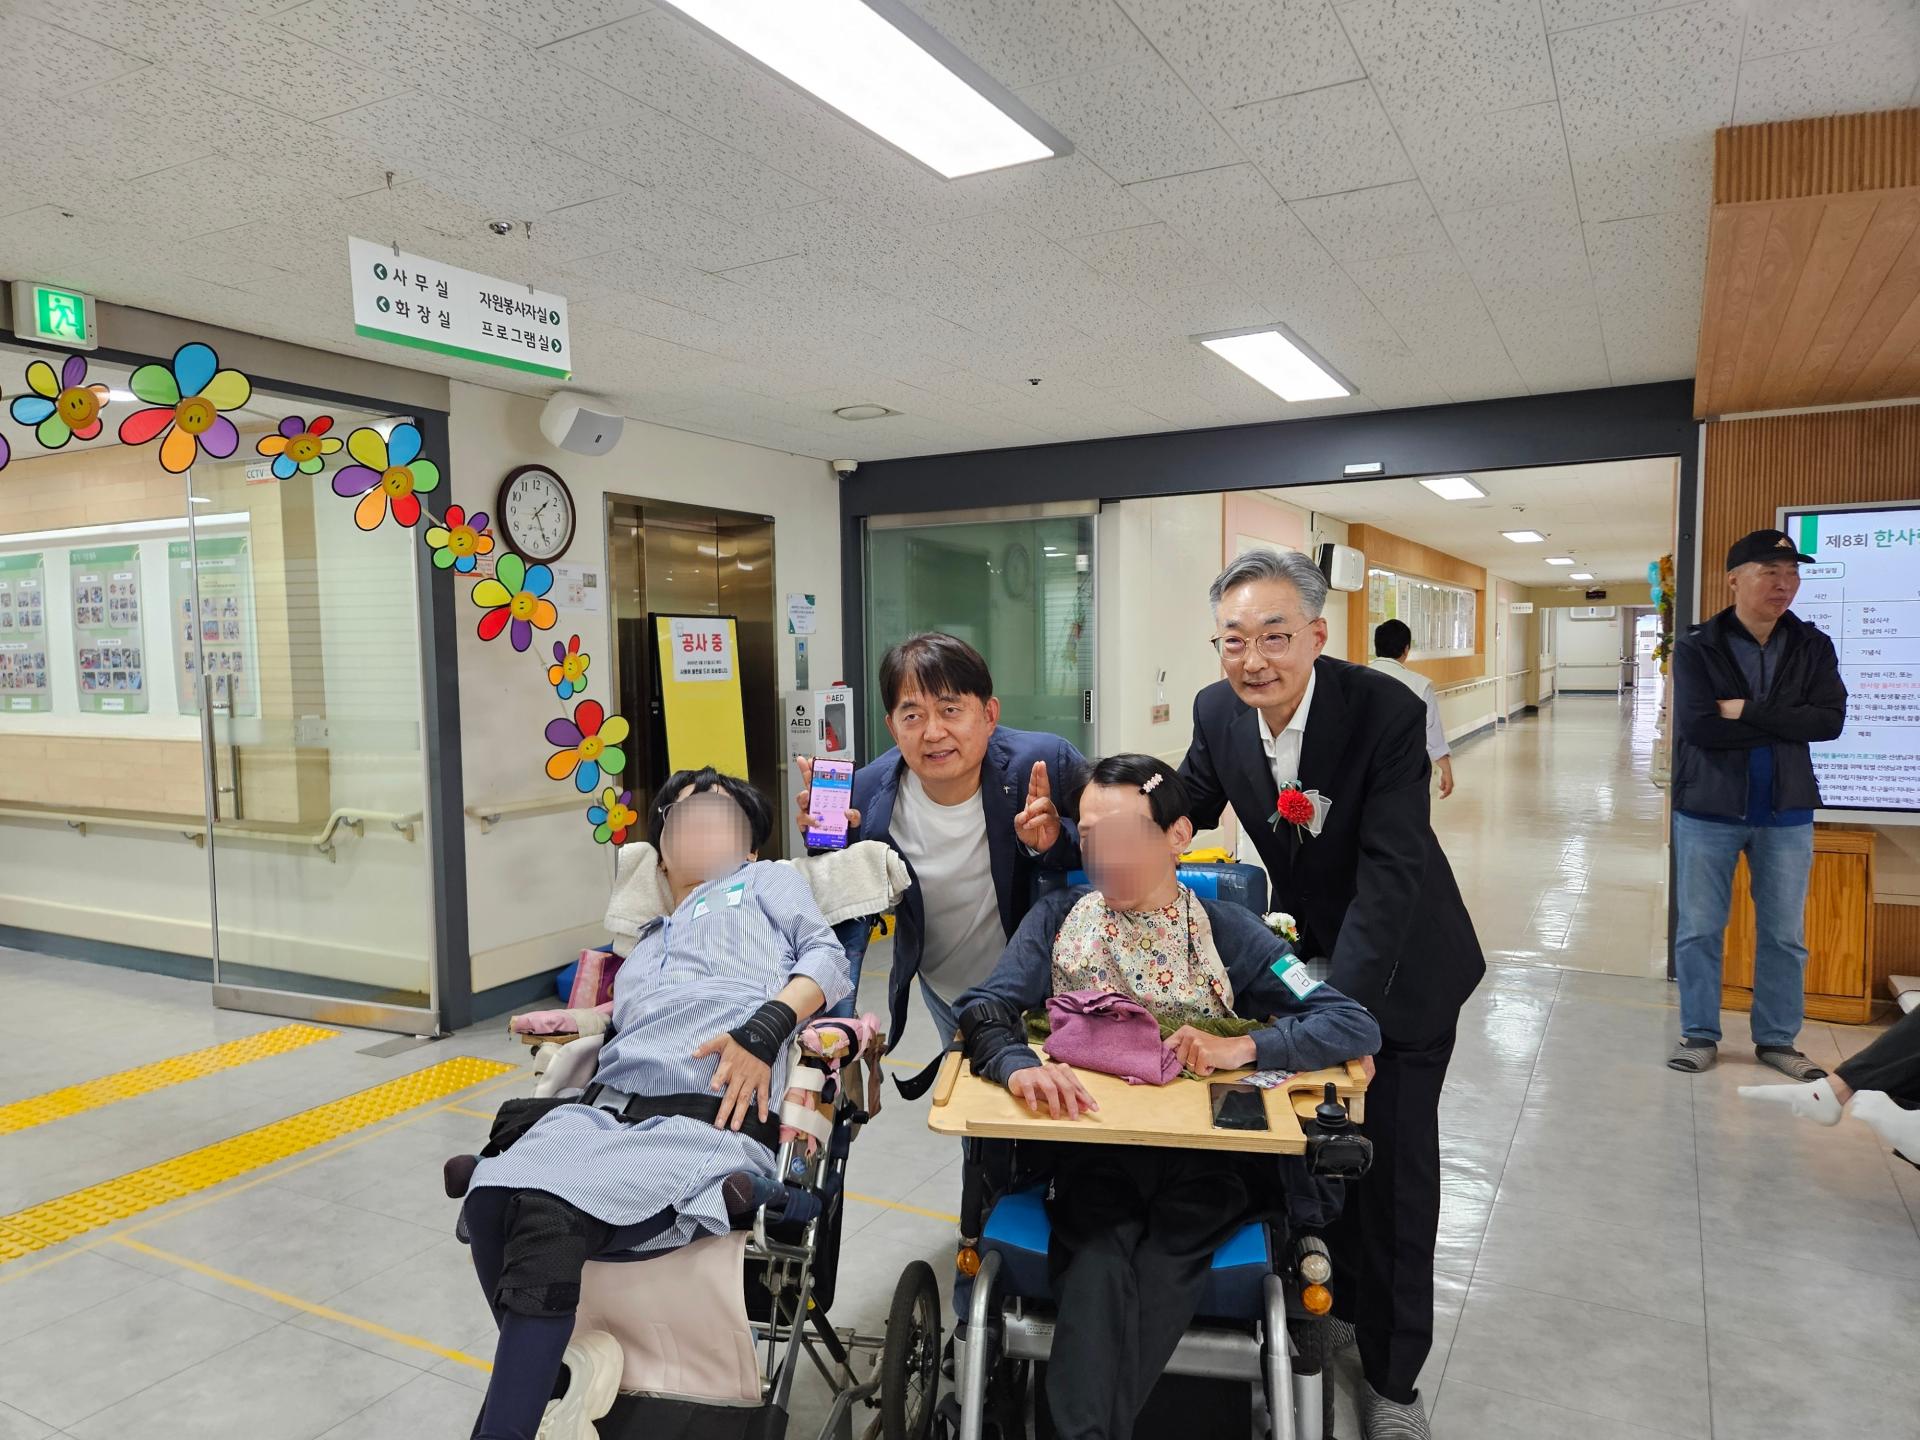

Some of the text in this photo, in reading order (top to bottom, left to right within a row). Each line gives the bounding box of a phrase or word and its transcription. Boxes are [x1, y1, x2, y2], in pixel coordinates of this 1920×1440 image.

[479, 291, 548, 324] 자원봉사자실
[482, 321, 549, 352] 프로그램실
[247, 469, 264, 479] CCTV
[521, 481, 528, 492] 11
[532, 479, 541, 490] 12
[545, 486, 549, 496] 1
[512, 491, 522, 502] 10
[552, 497, 558, 507] 2
[510, 506, 517, 515] 9
[555, 513, 561, 523] 3
[513, 521, 520, 531] 8
[552, 528, 557, 537] 4
[522, 534, 528, 544] 7
[545, 537, 551, 547] 5
[1825, 533, 1868, 549] 제8회
[533, 540, 539, 550] 6
[682, 633, 722, 652] 공사 중
[831, 694, 845, 702] AED
[790, 718, 811, 727] AED
